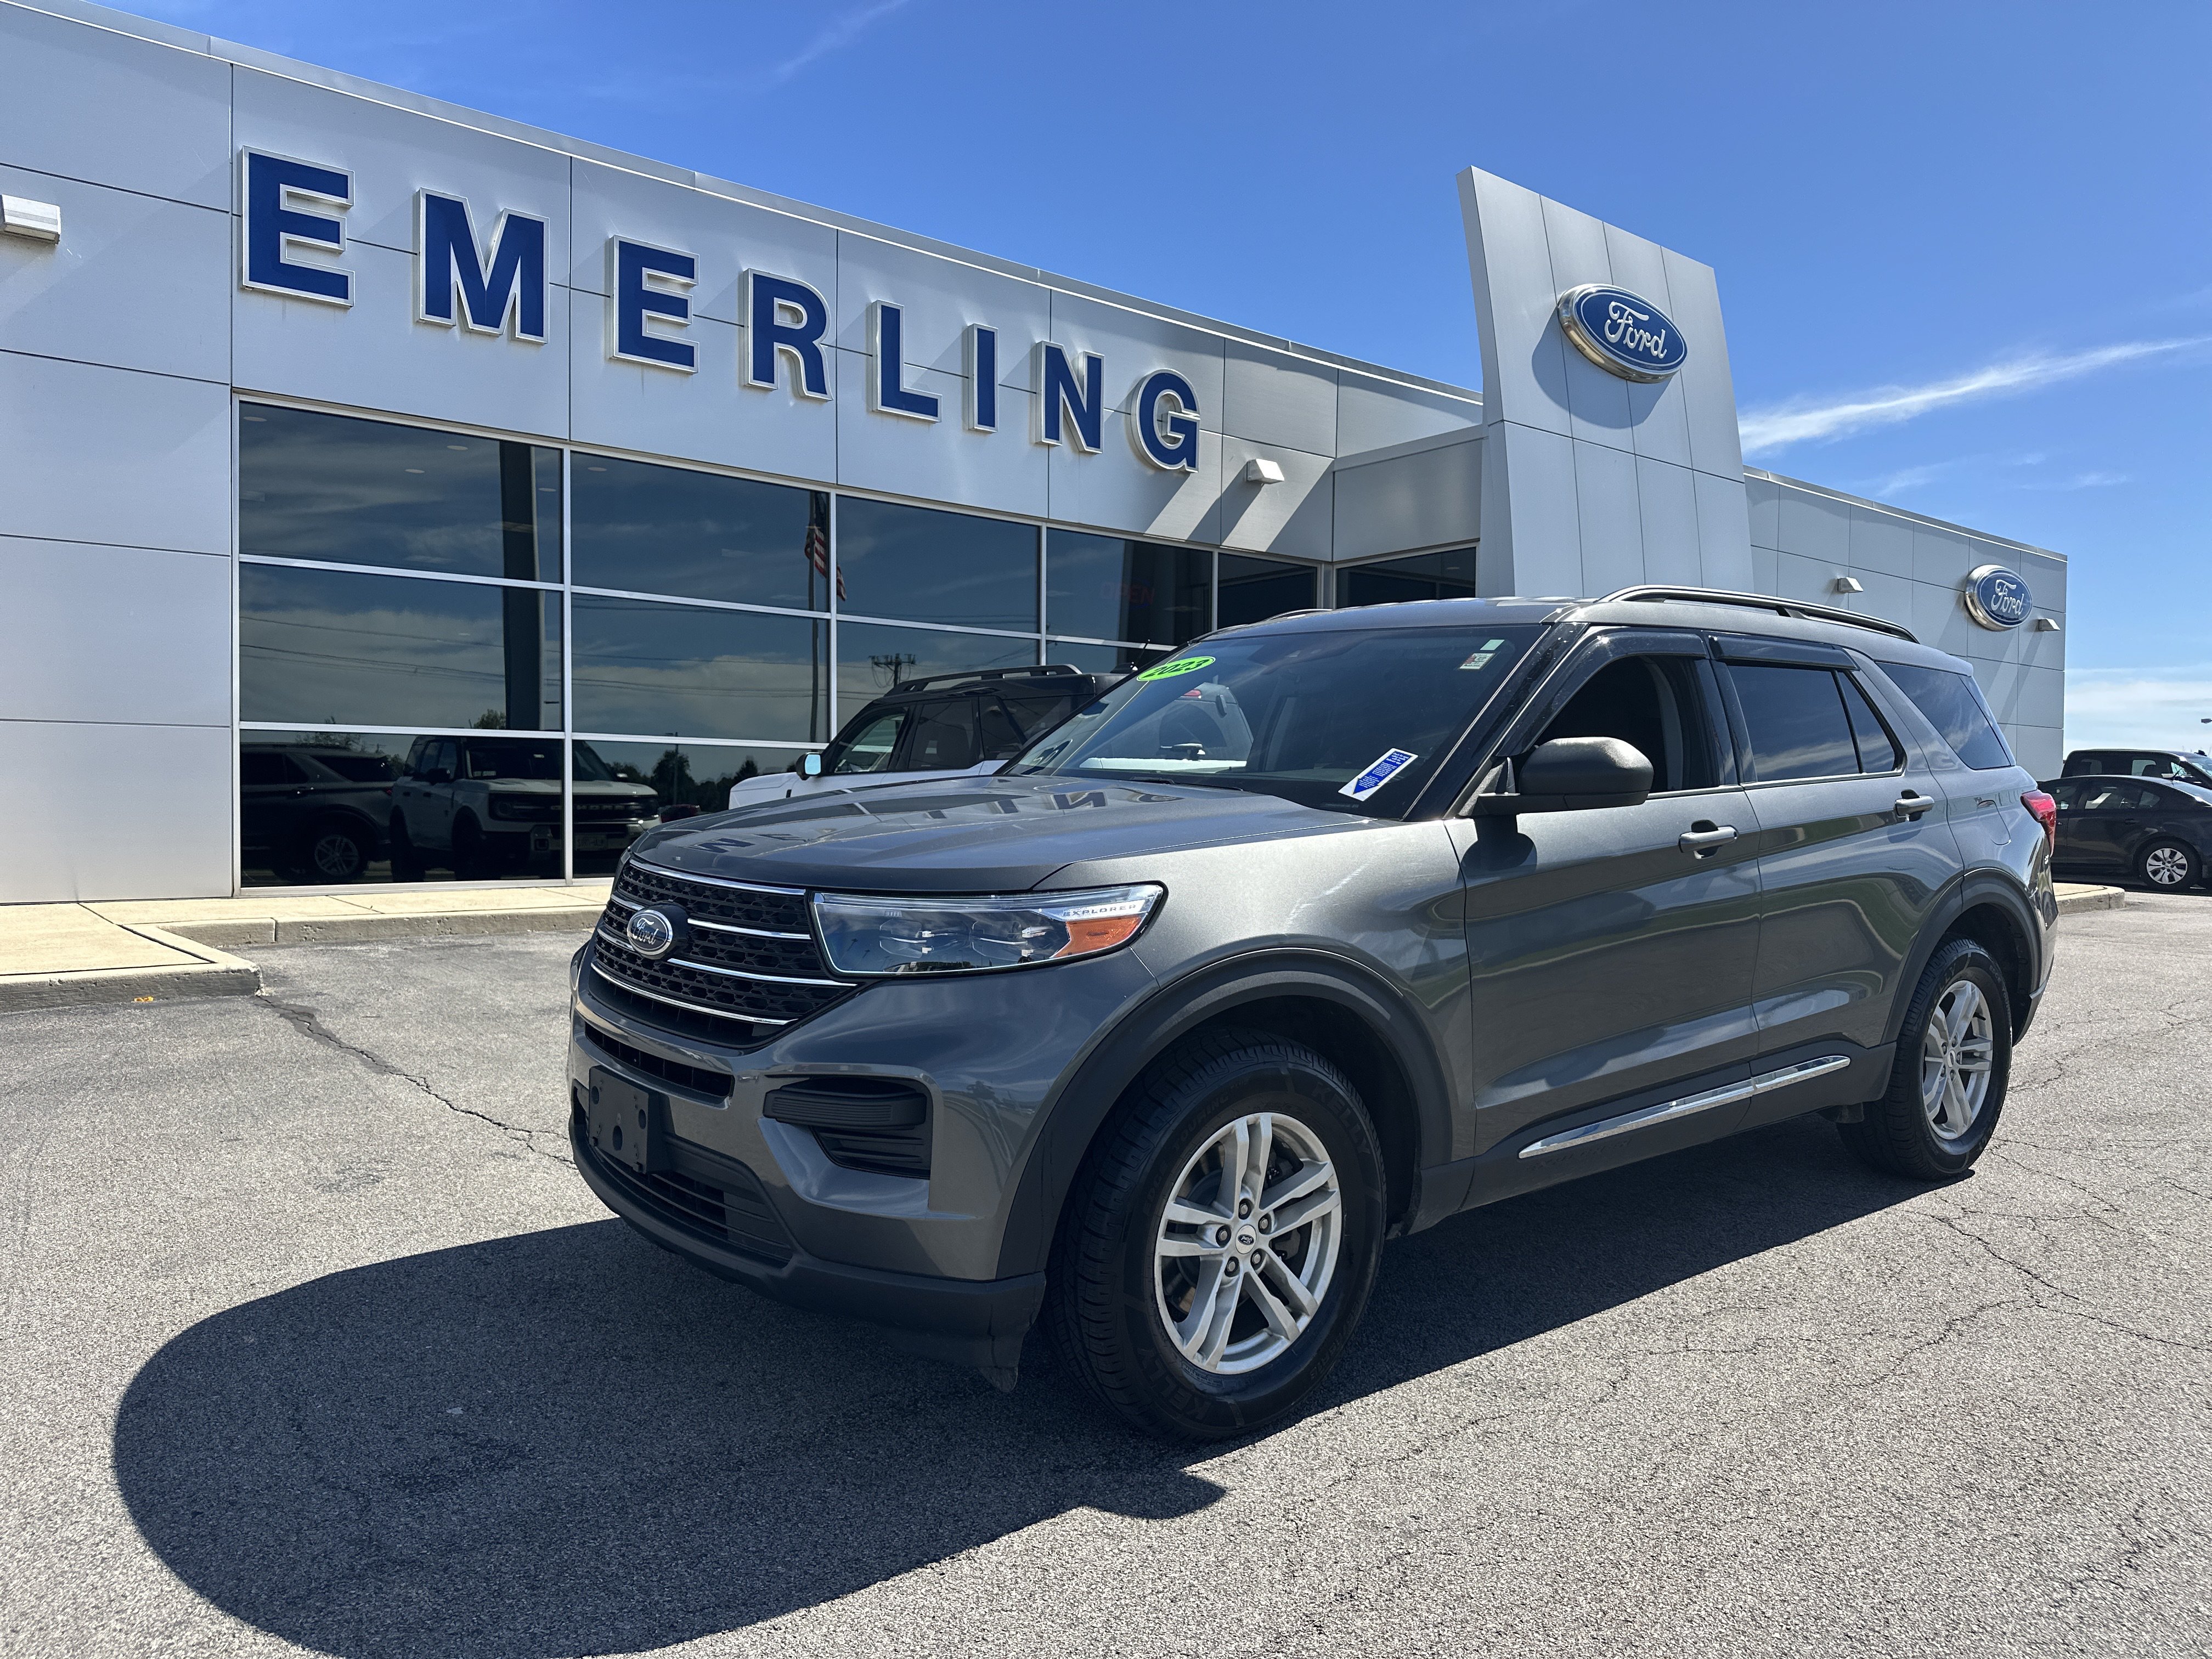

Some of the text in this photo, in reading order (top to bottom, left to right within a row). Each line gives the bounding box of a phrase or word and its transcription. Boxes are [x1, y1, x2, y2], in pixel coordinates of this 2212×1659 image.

[240, 145, 1201, 473] EMERLING
[1604, 301, 1667, 358] Ford
[1990, 579, 2024, 616] Ford
[1141, 658, 1210, 679] 2023
[1063, 904, 1137, 916] EXPLORER
[633, 917, 659, 945] Ford
